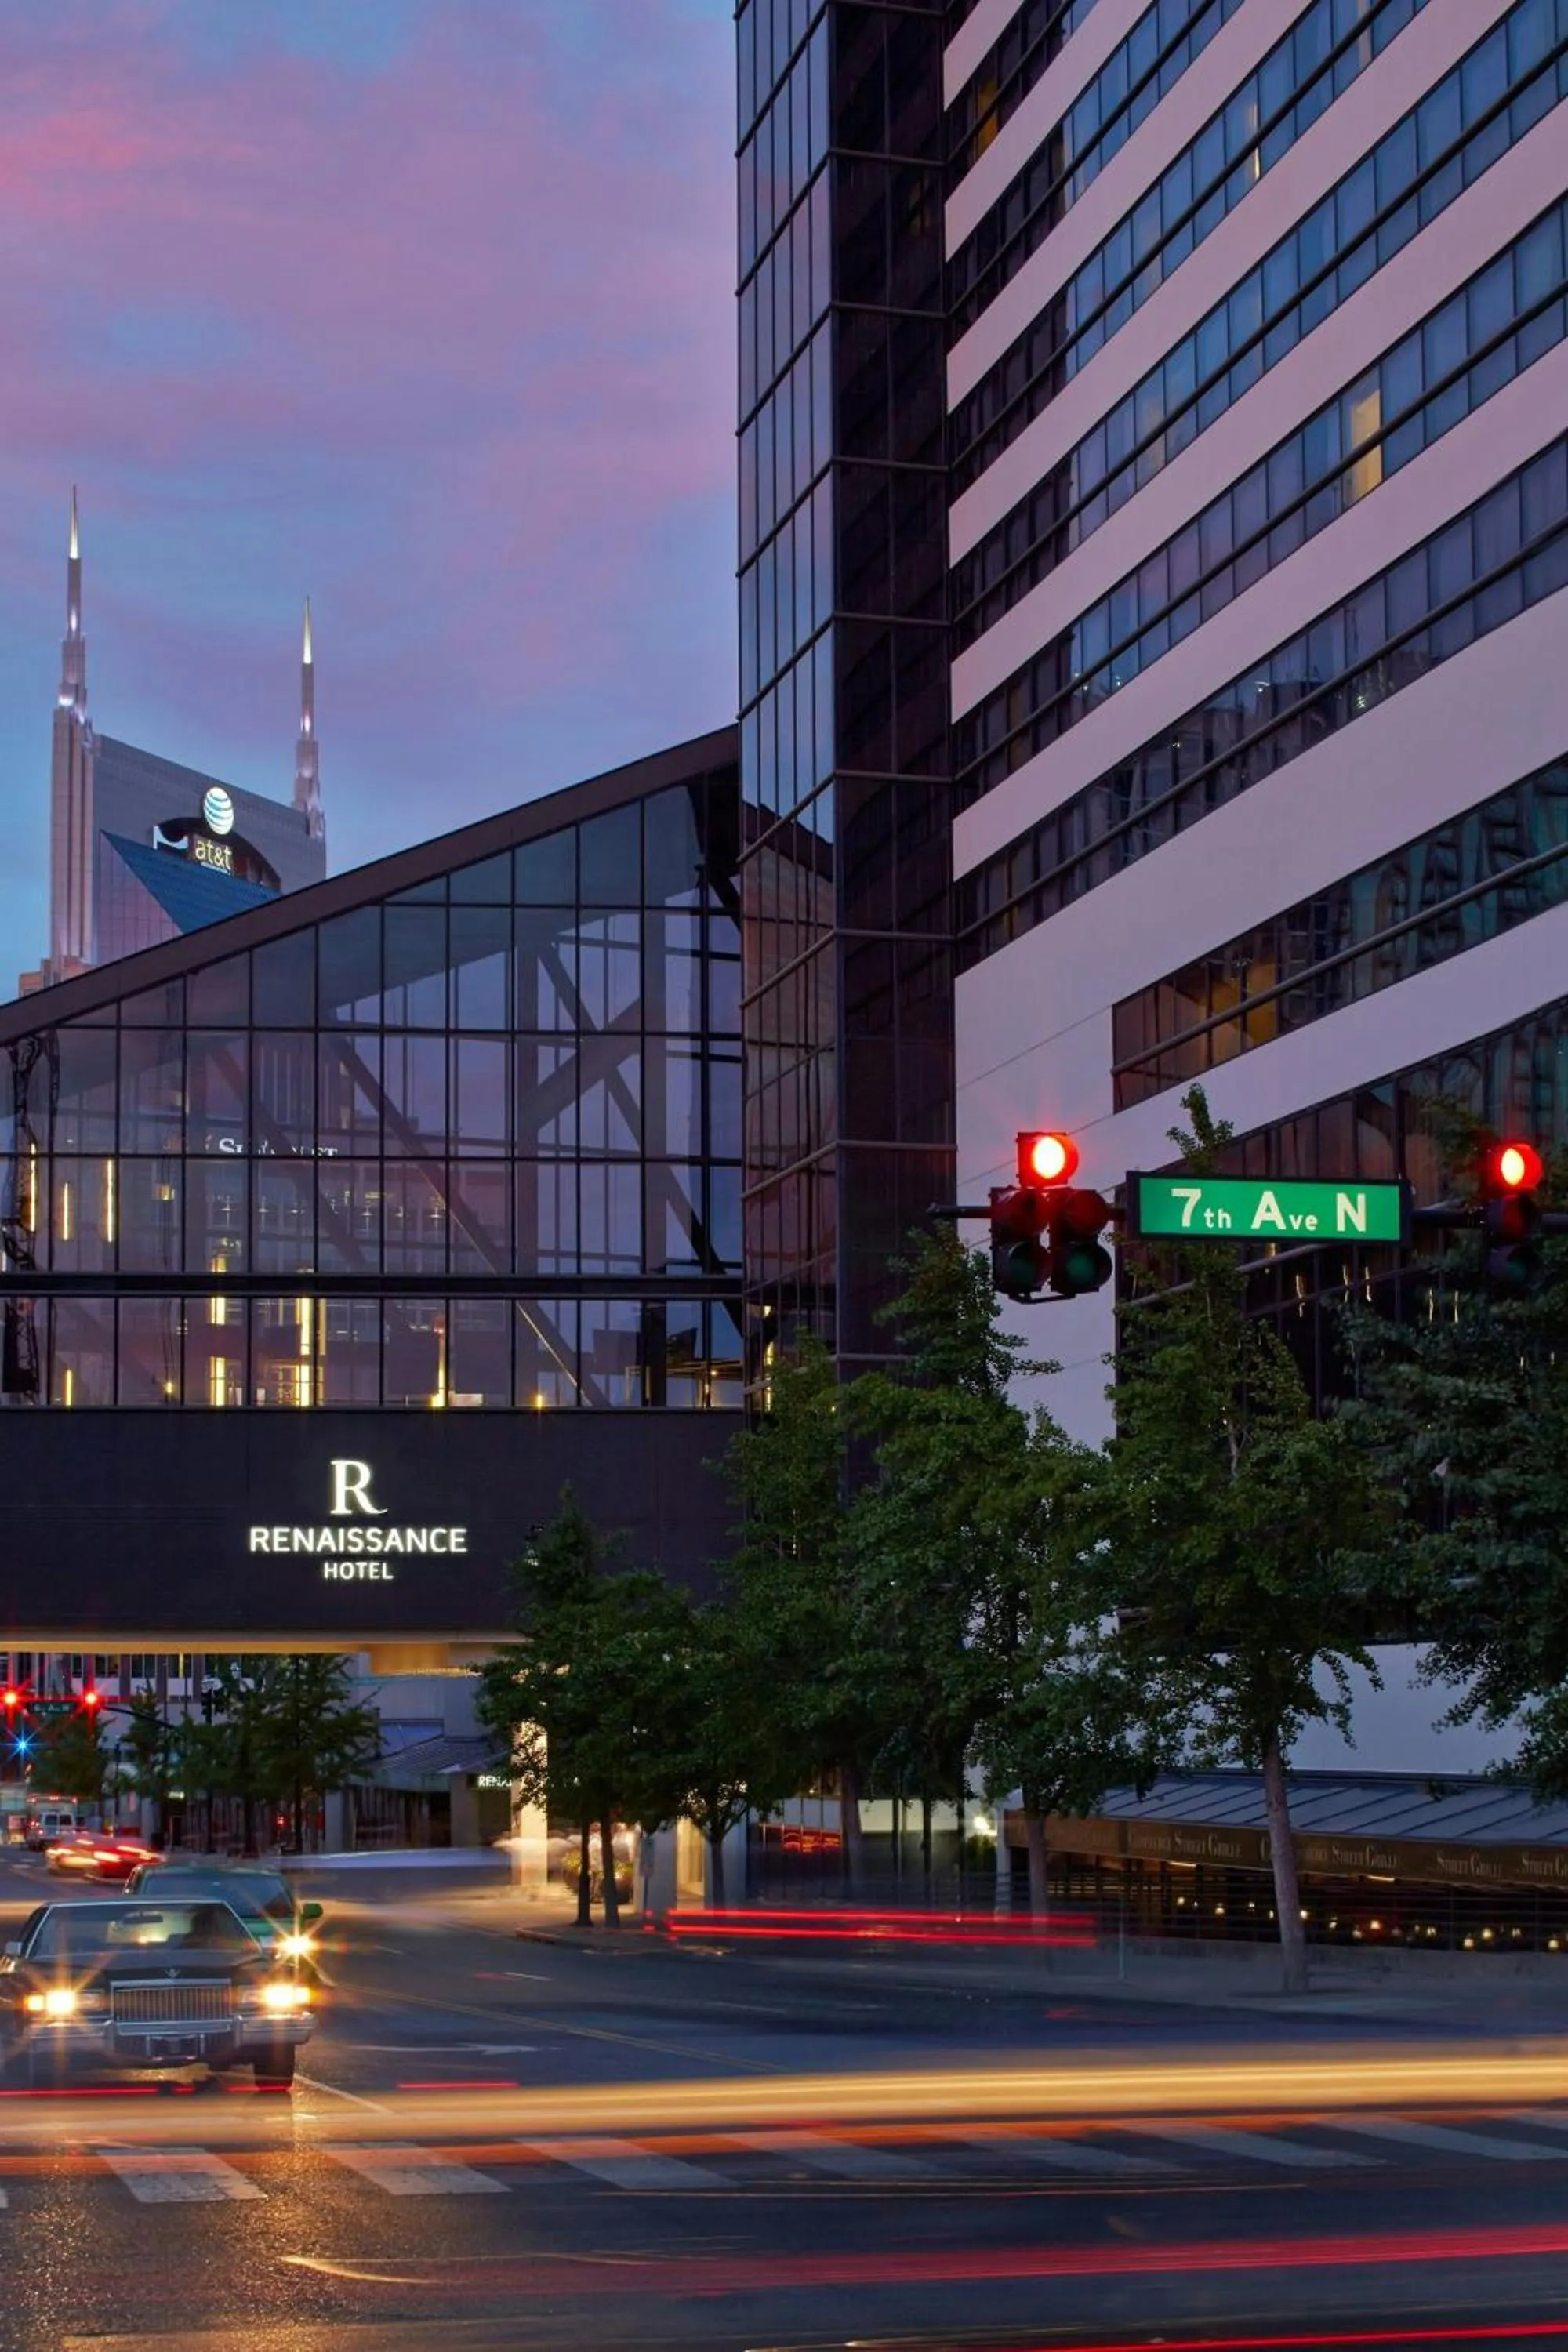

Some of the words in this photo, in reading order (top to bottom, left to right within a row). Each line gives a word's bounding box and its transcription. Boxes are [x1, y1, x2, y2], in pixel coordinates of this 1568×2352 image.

[195, 840, 232, 870] at&t
[1171, 1188, 1232, 1229] 7th
[1250, 1190, 1318, 1230] Ave
[1335, 1192, 1367, 1232] N
[330, 1459, 388, 1515] R
[249, 1527, 468, 1552] RENAISSANCE
[323, 1562, 394, 1580] HOTEL
